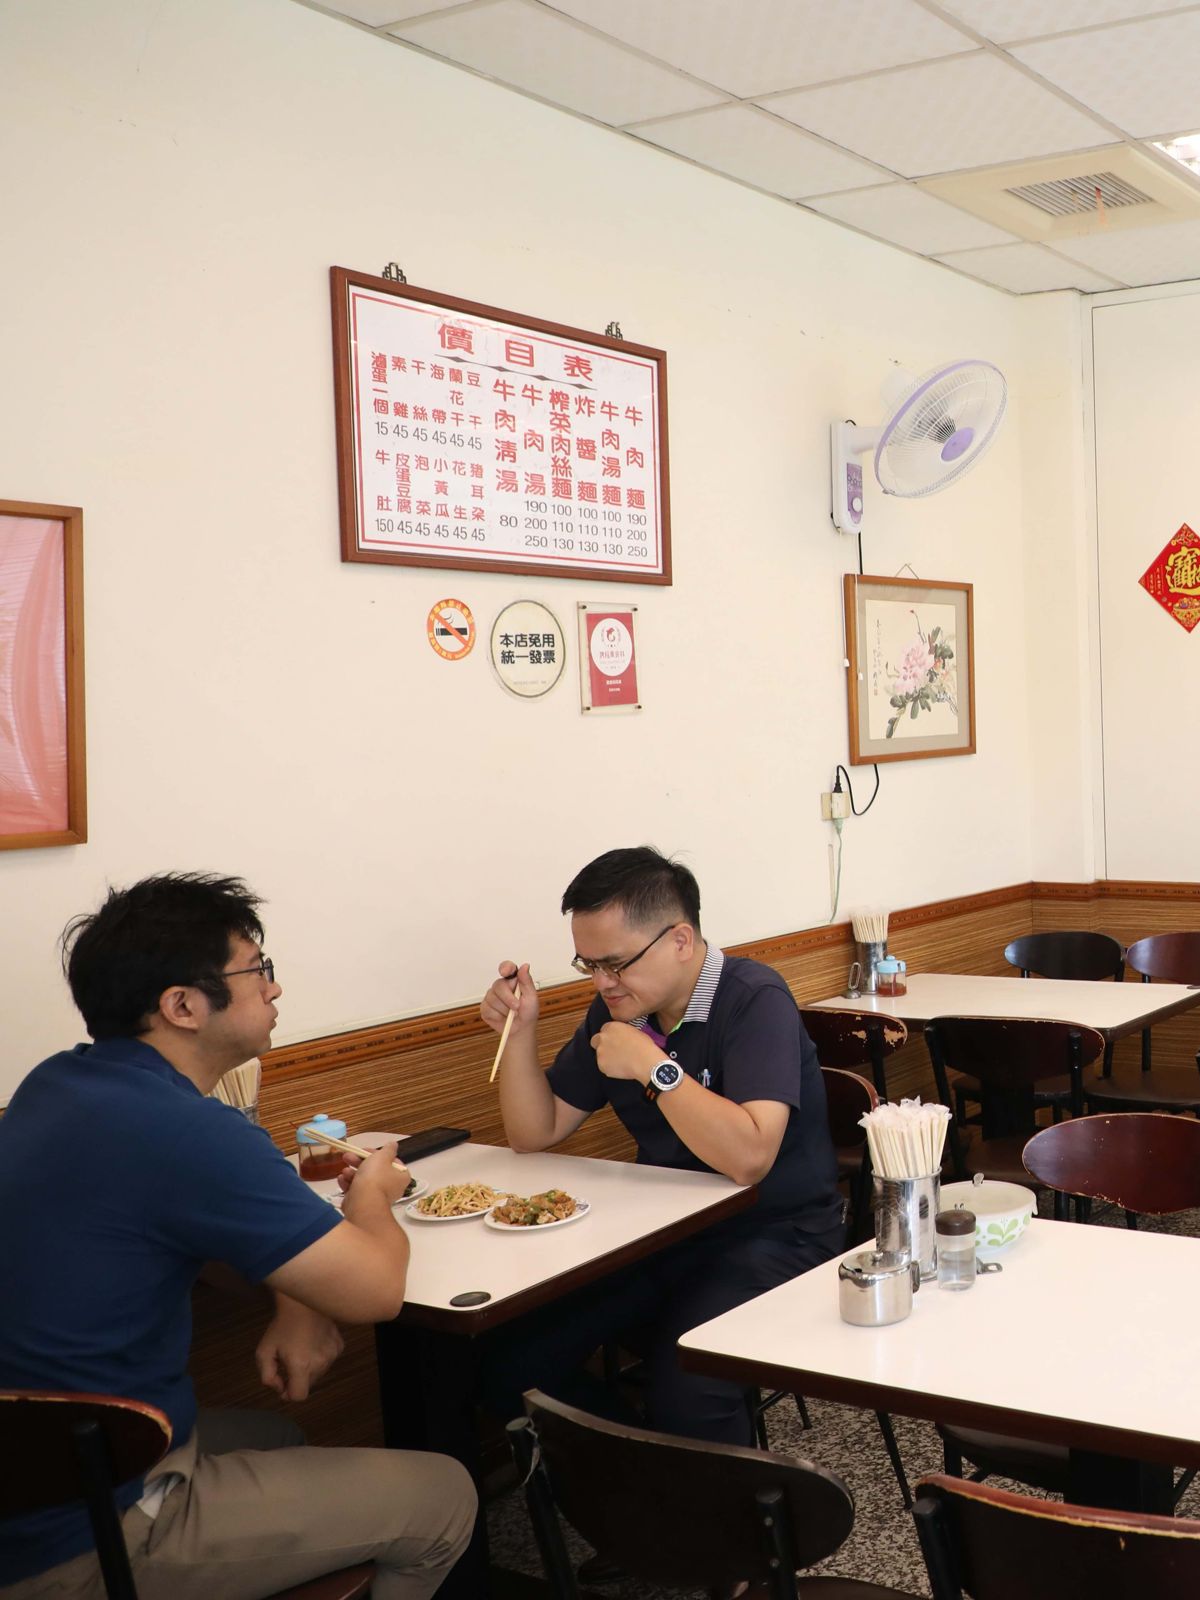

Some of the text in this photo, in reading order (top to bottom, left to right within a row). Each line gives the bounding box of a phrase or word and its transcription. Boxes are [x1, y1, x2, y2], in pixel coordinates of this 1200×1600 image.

[438, 323, 593, 382] 價目表
[391, 355, 409, 419] 素雞
[467, 371, 482, 430] 豆干
[375, 421, 482, 451] 15 45 45 45 45 45
[521, 384, 546, 496] 牛肉湯
[624, 405, 646, 510] 牛肉麵
[375, 449, 392, 511] 牛肚
[395, 453, 411, 514] 皮蛋豆腐
[414, 454, 431, 516] 泡菜
[452, 460, 467, 520] 花生
[375, 518, 486, 541] 150 45 45 45 45 45
[499, 514, 647, 542] 80 200 110 110 110 200
[524, 500, 647, 526] 190 100 100 100 190
[524, 535, 648, 558] 250 130 130 130 250
[499, 633, 555, 648] 本店免用
[500, 650, 556, 665] 統一發票
